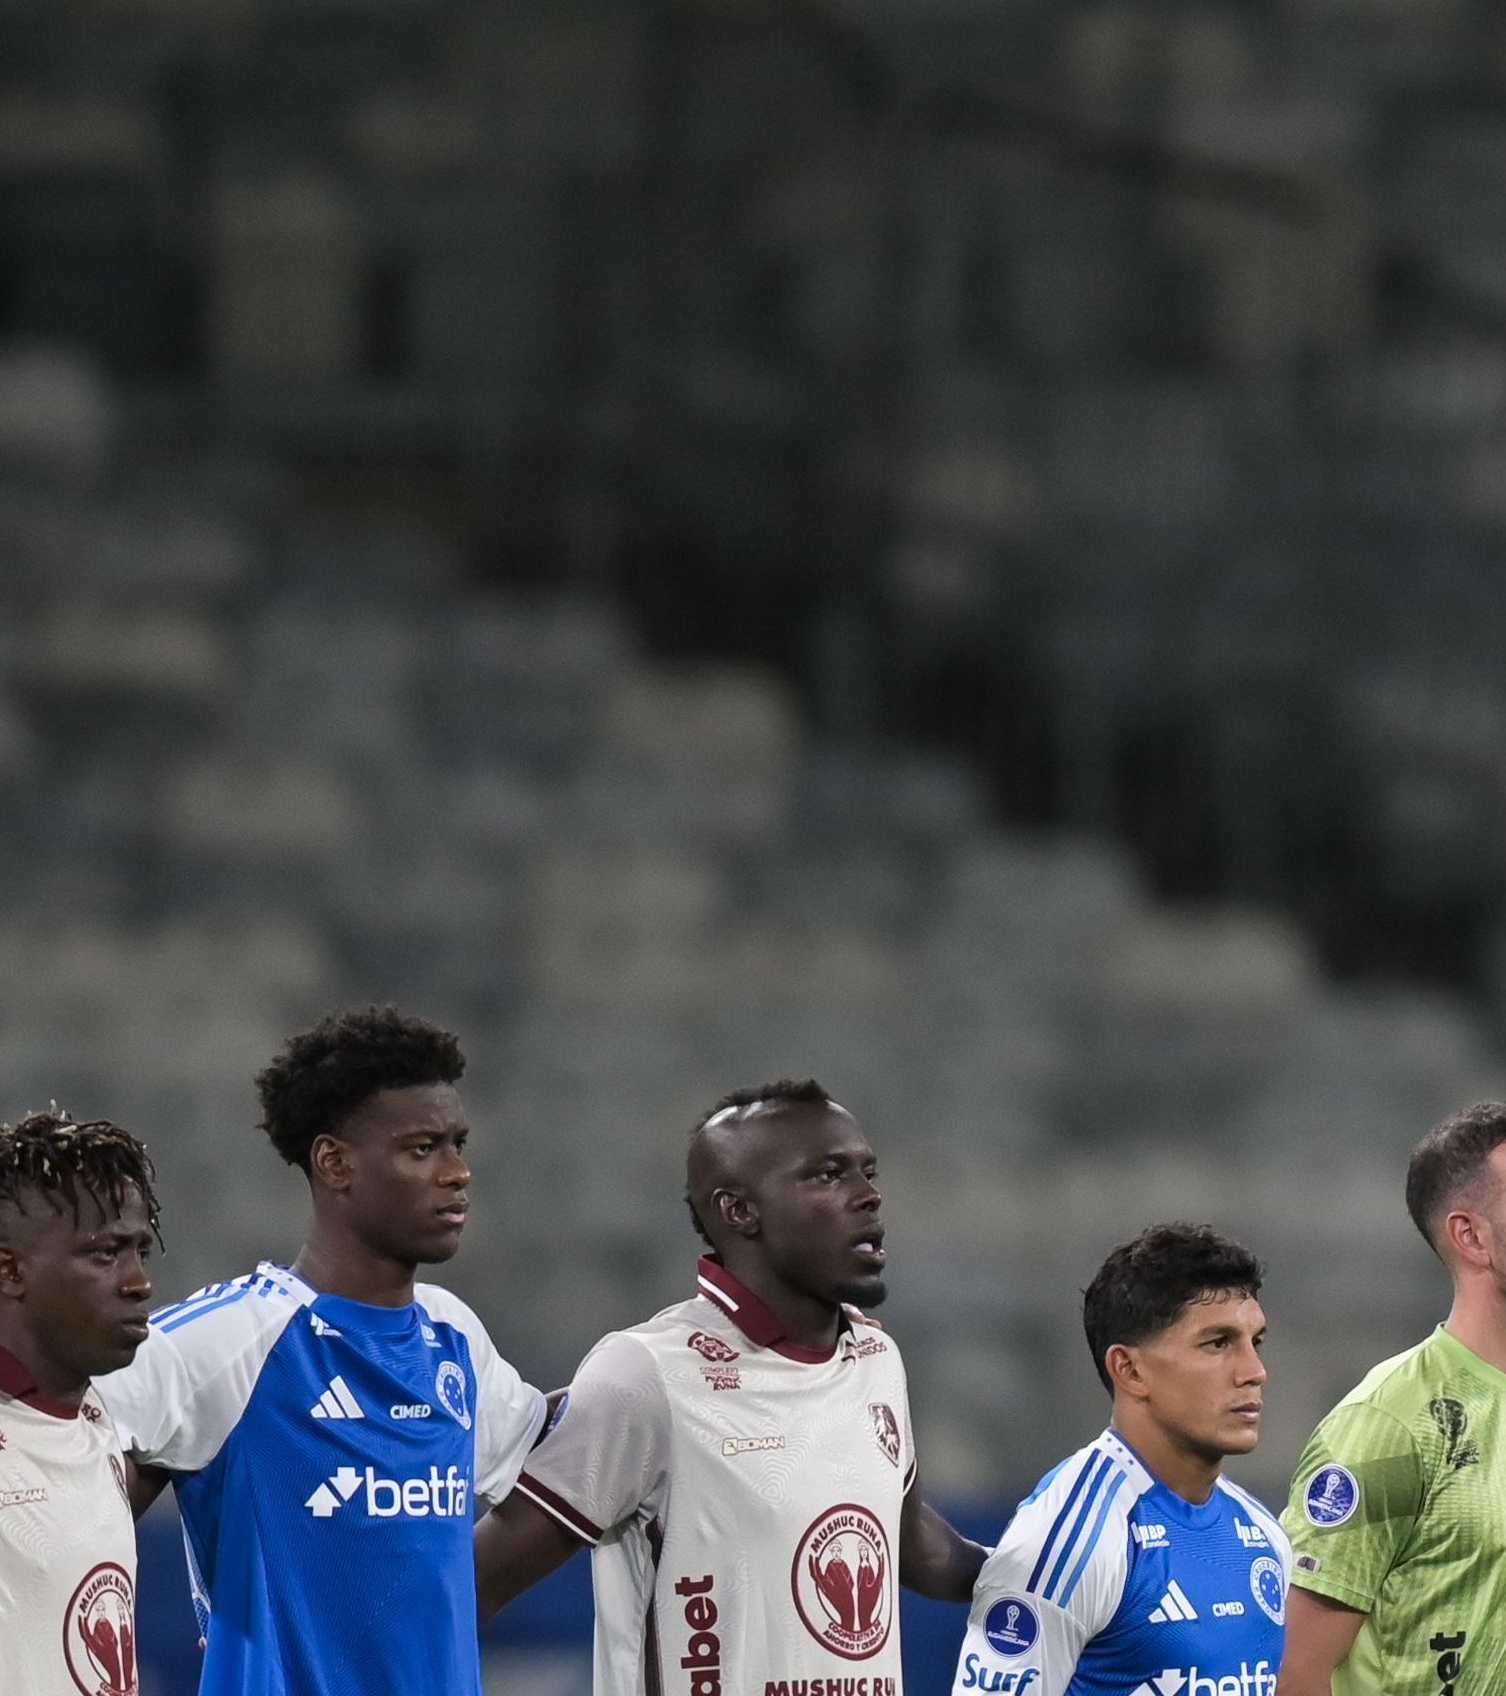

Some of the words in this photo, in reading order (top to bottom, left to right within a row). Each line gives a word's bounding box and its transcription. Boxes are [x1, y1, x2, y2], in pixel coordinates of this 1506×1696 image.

[389, 1403, 432, 1420] CIMED
[810, 1514, 858, 1553] MUSHUC
[857, 1520, 883, 1553] RUNA
[79, 1573, 114, 1614] MUSHUC
[1212, 1601, 1245, 1617] CIMED
